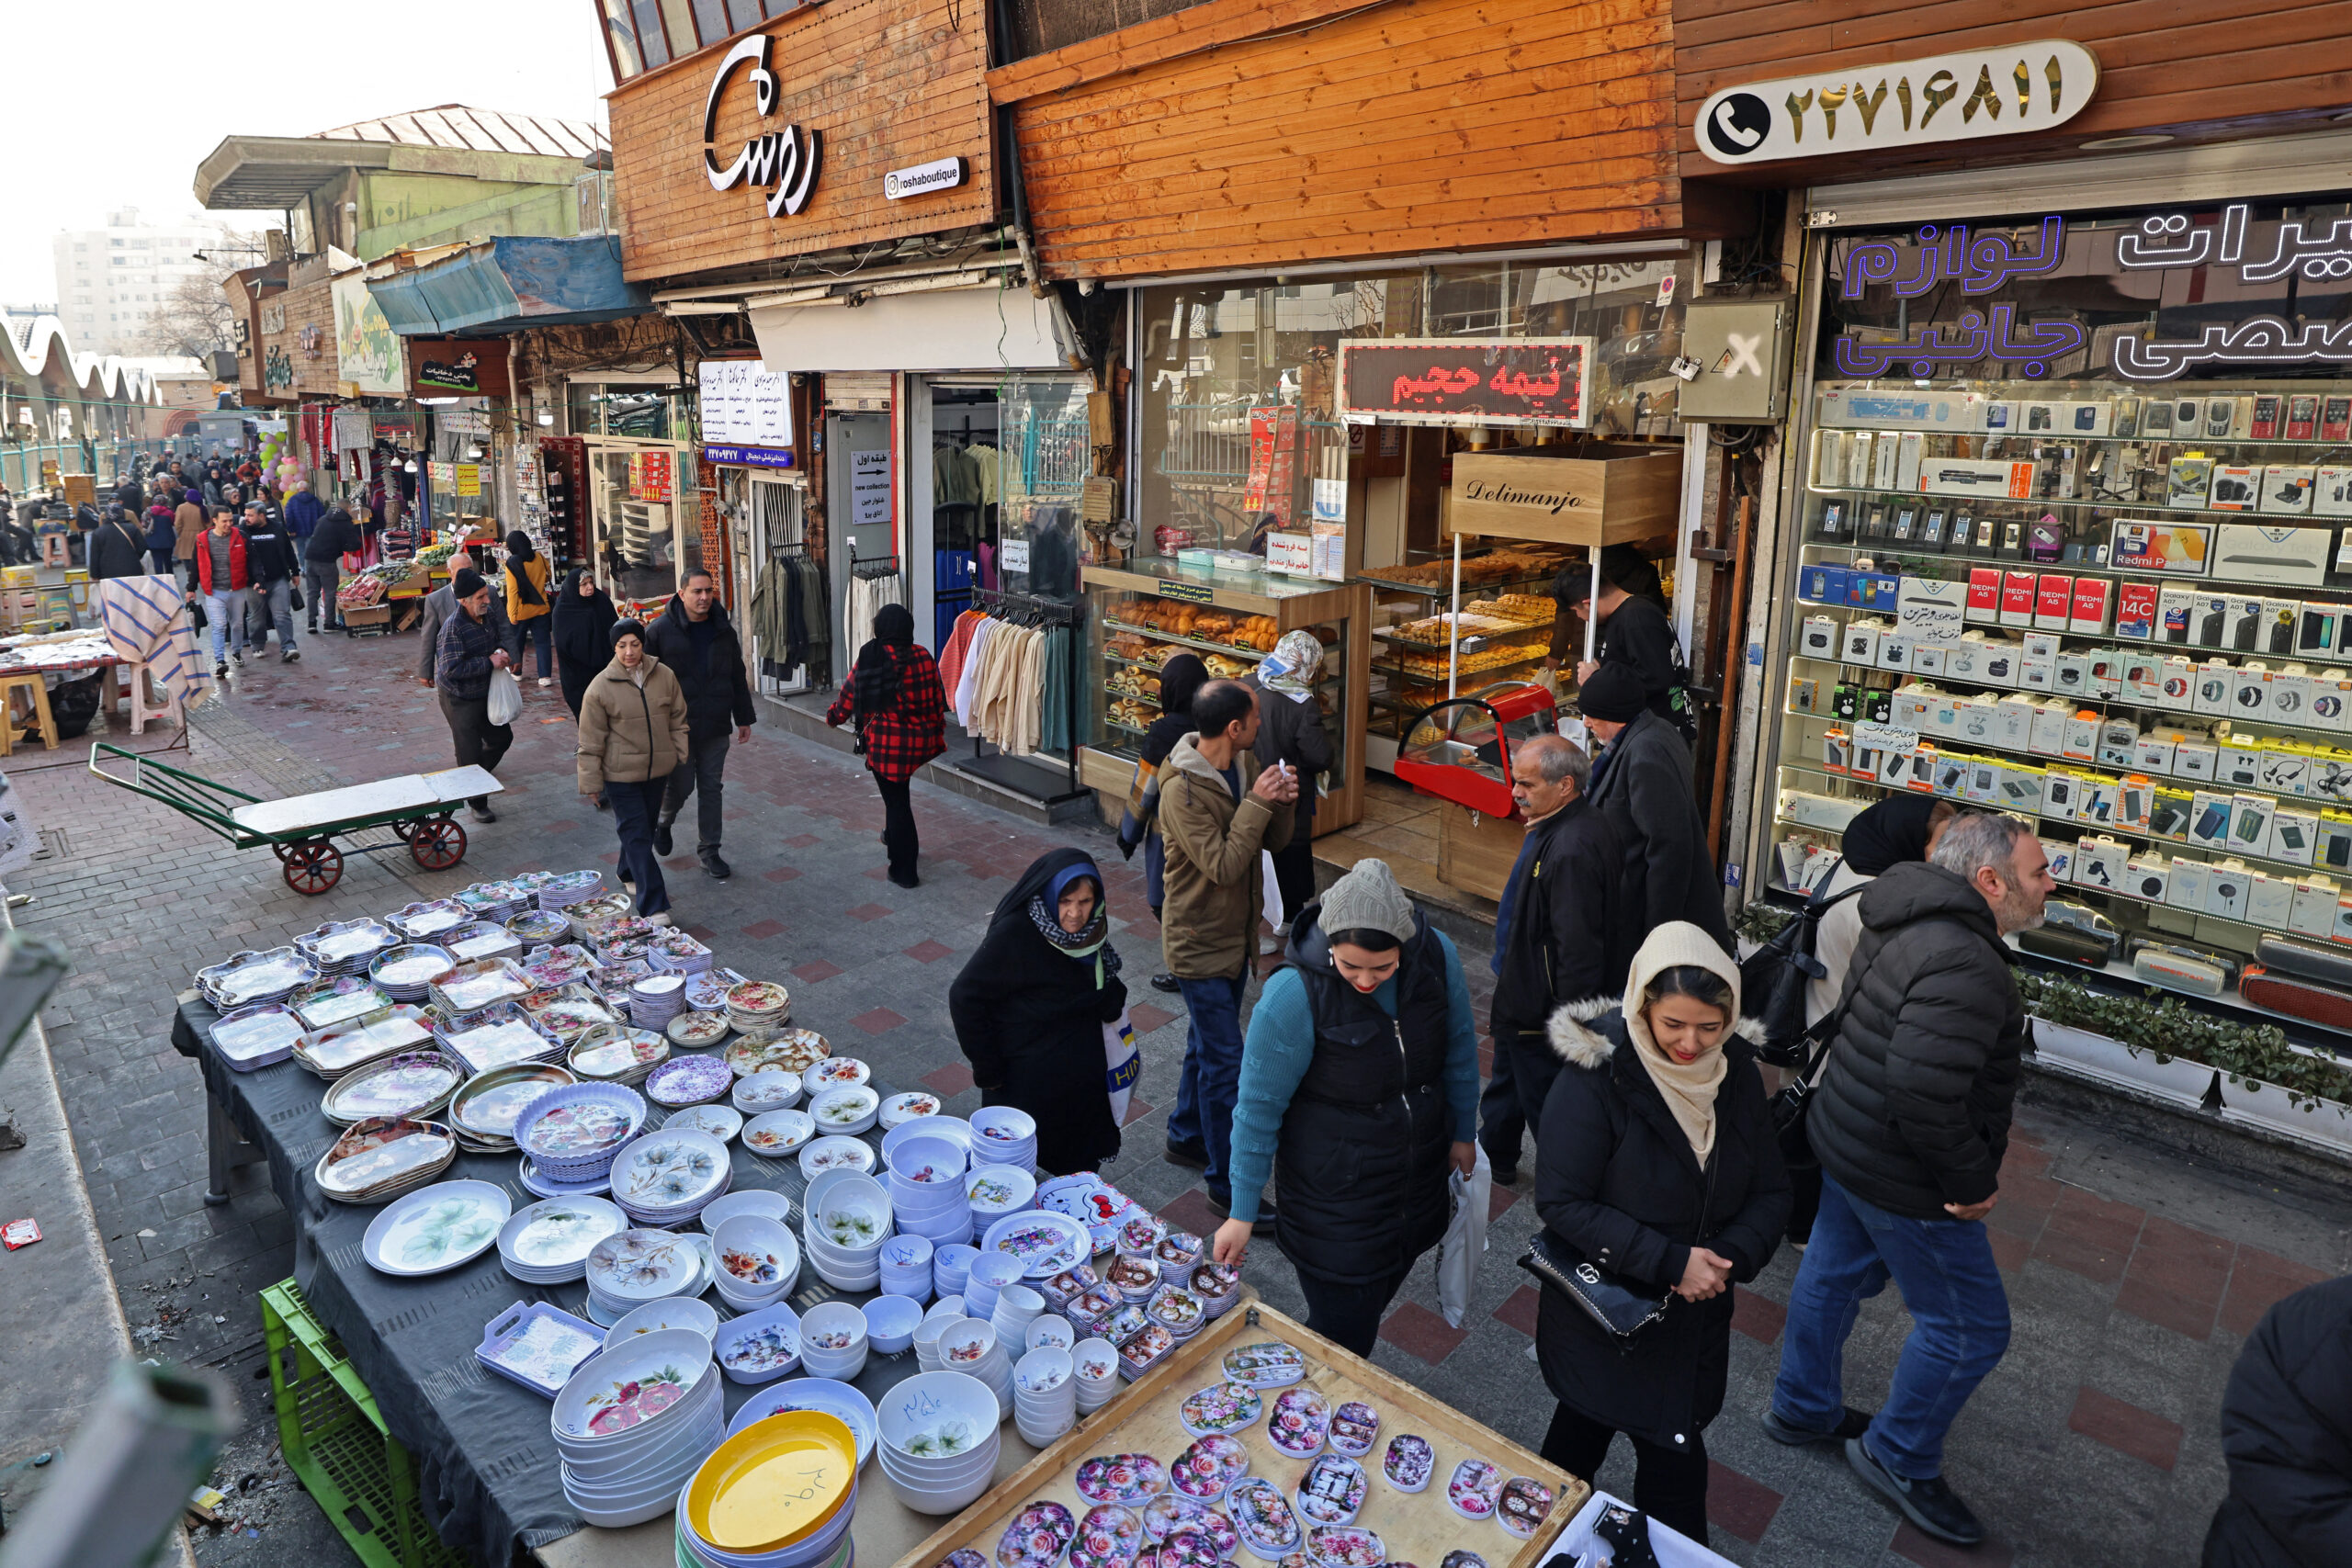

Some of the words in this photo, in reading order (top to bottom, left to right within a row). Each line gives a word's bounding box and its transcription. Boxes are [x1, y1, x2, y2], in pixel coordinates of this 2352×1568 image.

[1784, 53, 2063, 144] ۲۲۷۱۶۸۱۱
[900, 168, 957, 189] roshaboutique
[1845, 215, 2063, 298] لوازم
[1836, 305, 2083, 378] جانبی
[1393, 366, 1480, 405] حجیم
[1489, 355, 1560, 408] نیمه
[857, 455, 870, 466] اول
[870, 454, 888, 465] طبقه
[1466, 479, 1586, 516] Delimanjo
[873, 510, 883, 518] اتاق
[1271, 541, 1296, 553] فروشنده
[1295, 561, 1309, 570] خانم
[2117, 554, 2153, 567] Redmi
[2155, 556, 2180, 568] Pad
[2183, 558, 2201, 570] SE
[1971, 583, 1996, 592] REDMI
[2005, 587, 2032, 597] REDMI
[2040, 591, 2067, 600] REDMI
[2075, 594, 2103, 604] REDMI
[2128, 593, 2148, 602] Redmi
[2163, 592, 2190, 602] Galaxy
[2120, 601, 2154, 617] 14C
[2265, 601, 2296, 610] Galaxy
[1903, 607, 1936, 627] ویترین
[1950, 613, 1962, 621] لطفا
[1939, 628, 1961, 640] توقف
